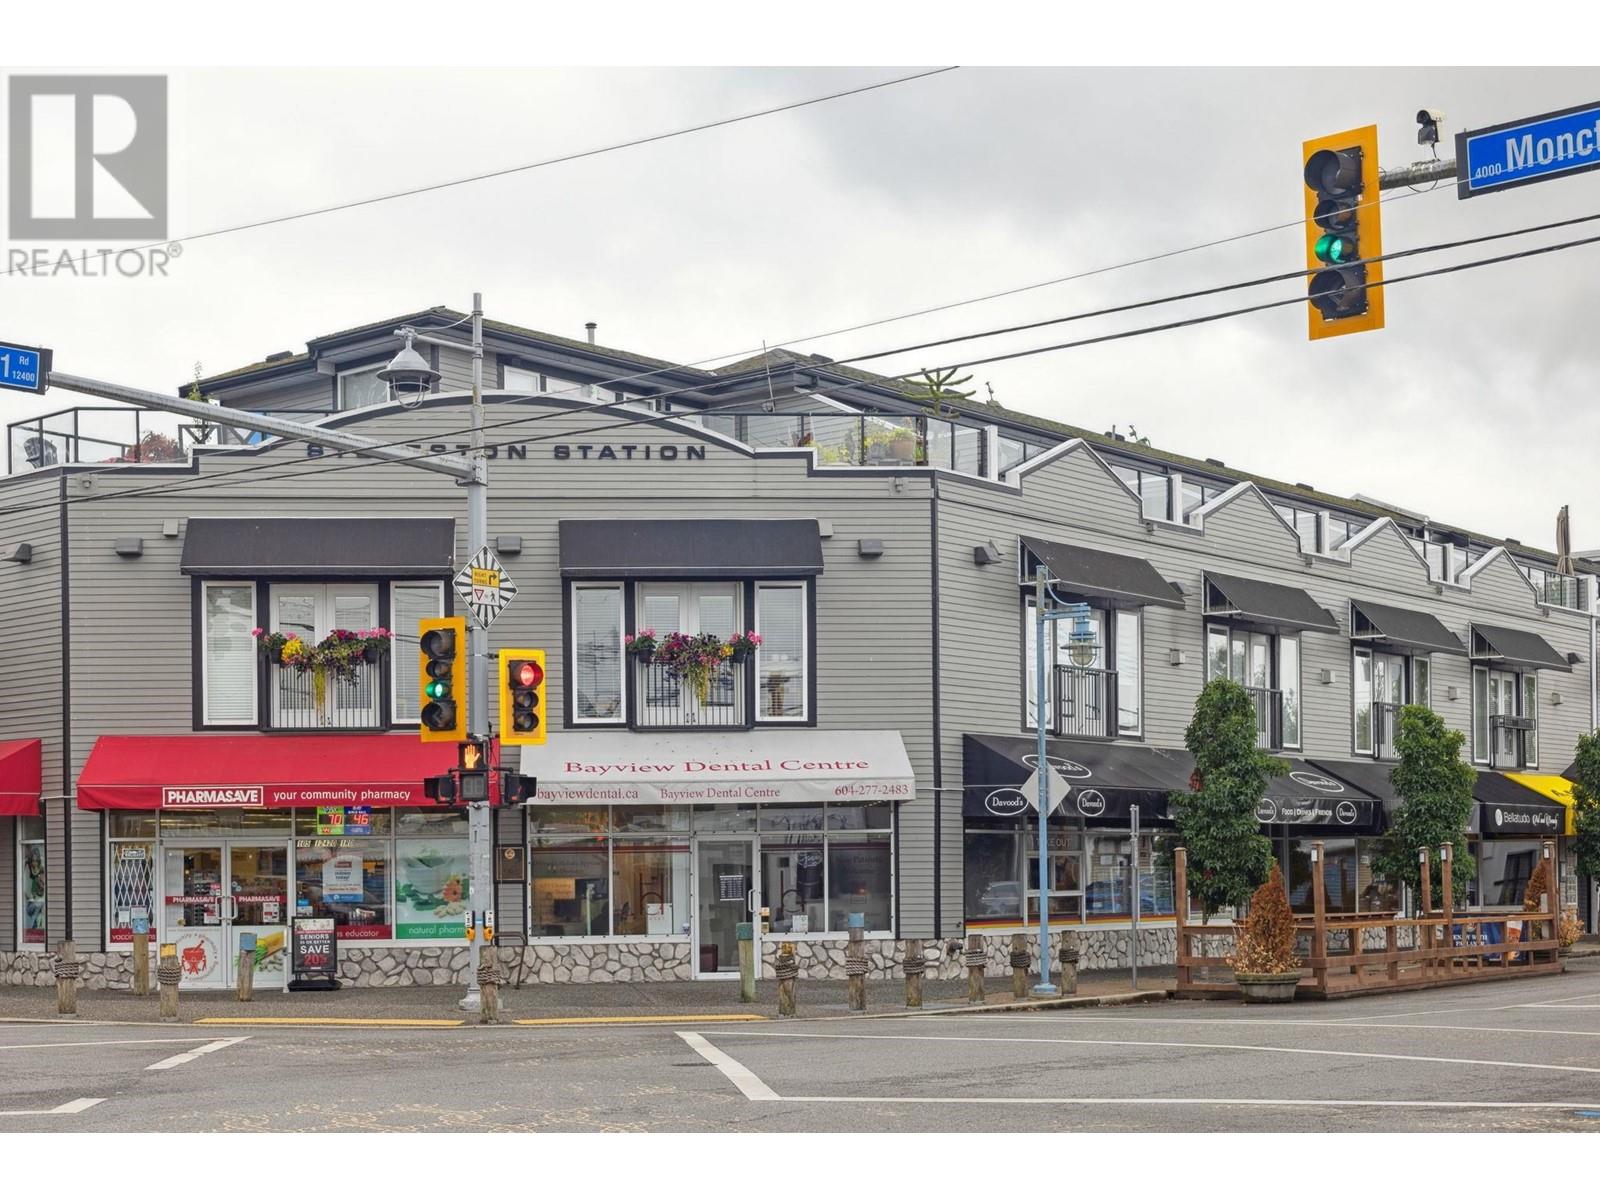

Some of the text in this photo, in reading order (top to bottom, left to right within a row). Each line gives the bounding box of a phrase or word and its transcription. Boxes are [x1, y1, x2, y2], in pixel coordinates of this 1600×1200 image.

[1475, 163, 1502, 179] 4000
[0, 353, 29, 378] 1 Rd
[12, 371, 35, 382] 12400
[553, 444, 707, 461] STATION
[564, 759, 869, 776] Bayview Dental Centre
[167, 790, 258, 803] PHARMASAVE
[273, 789, 410, 802] your community pharmacy
[537, 784, 909, 801] bayviewdental.ca Bayview Dental Centre 604-277-2483
[992, 796, 1024, 807] Davood's
[328, 814, 342, 825] 70
[353, 814, 369, 825] 46
[345, 929, 379, 937] educator
[408, 926, 437, 934] natural
[300, 945, 330, 954] SAVE
